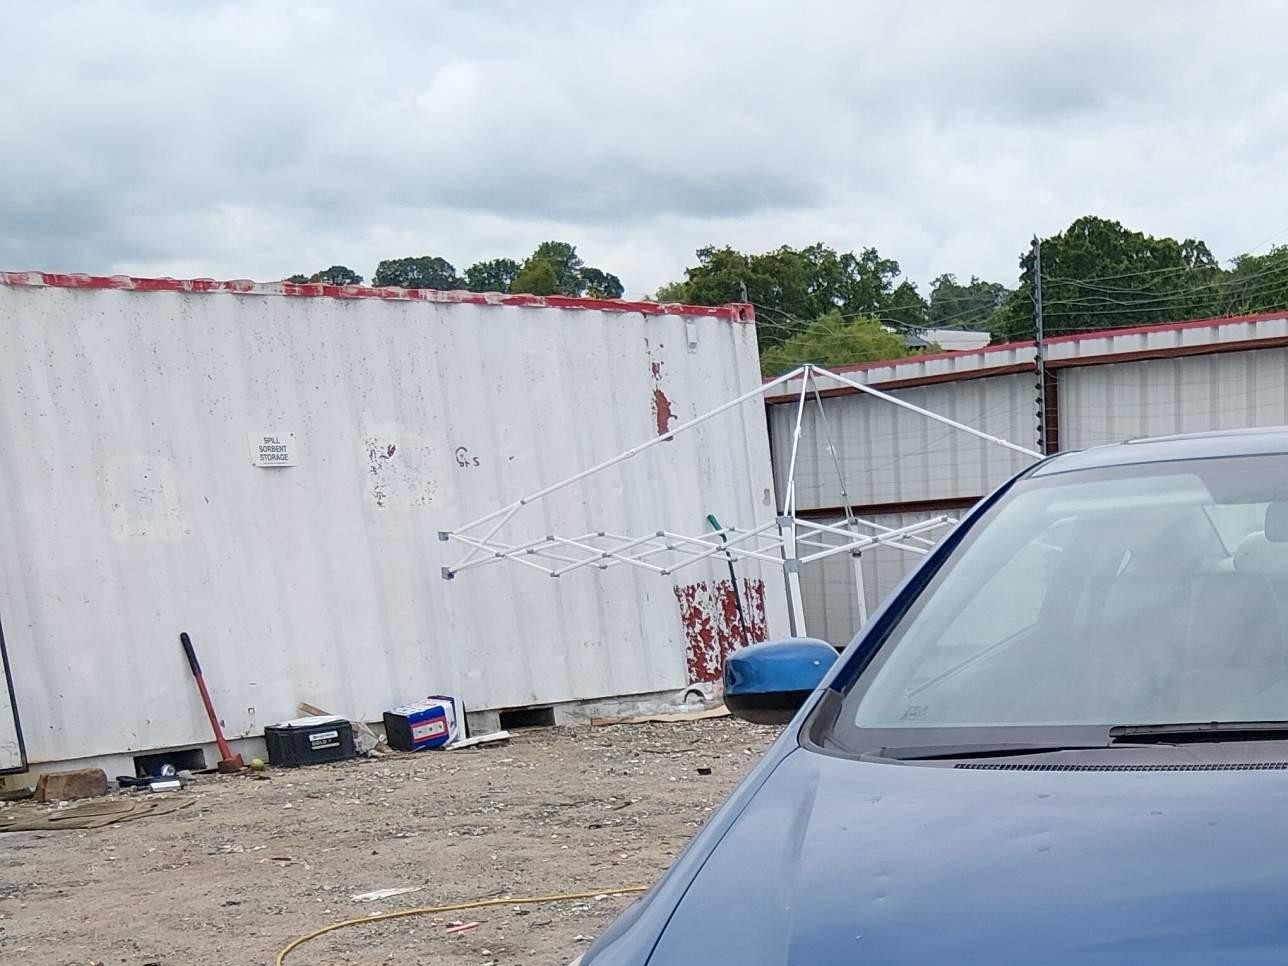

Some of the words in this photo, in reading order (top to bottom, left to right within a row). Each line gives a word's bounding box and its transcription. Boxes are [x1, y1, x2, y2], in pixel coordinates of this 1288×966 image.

[263, 436, 281, 445] SPILL
[258, 445, 288, 453] SORBENT
[259, 453, 289, 461] STORAGE
